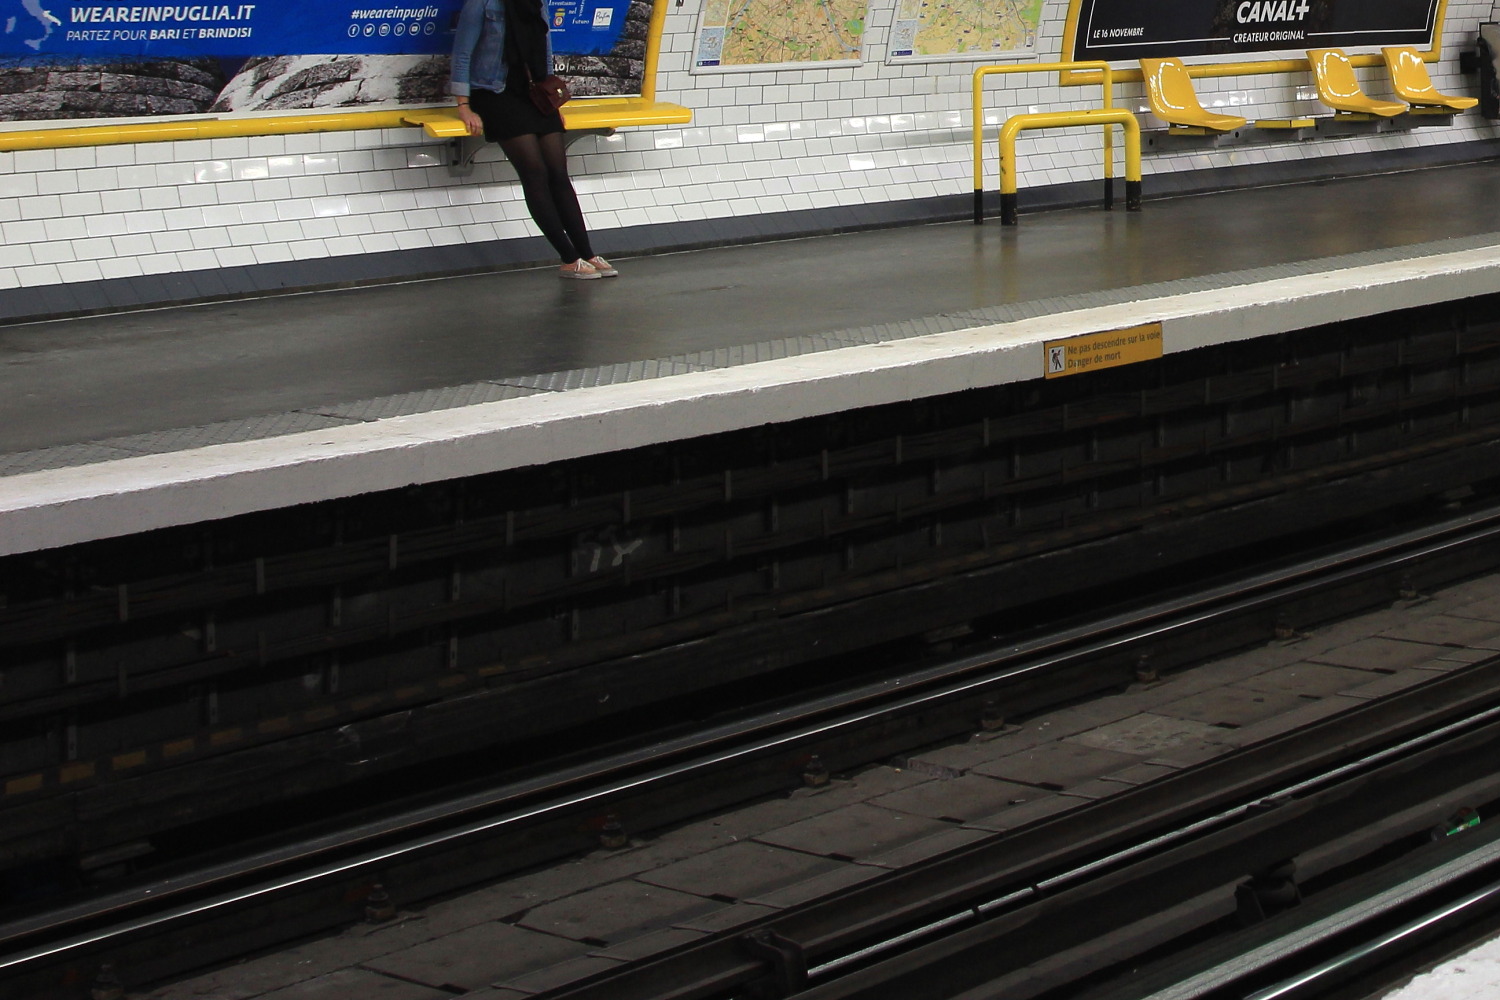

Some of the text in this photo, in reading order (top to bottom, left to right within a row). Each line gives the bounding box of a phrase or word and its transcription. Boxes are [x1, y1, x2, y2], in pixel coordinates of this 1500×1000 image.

[71, 4, 256, 23] WEAREINPUGLIA.IT
[351, 5, 439, 21] #weareinpuglia
[67, 27, 252, 41] PARTEZ POUR BARI ET BRINDISI
[1093, 27, 1145, 39] LE 16 NOVEMBRE
[1269, 30, 1305, 41] ORIGINAL
[1068, 331, 1161, 356] Ne pas descendre sur la voie
[1068, 351, 1121, 369] Danger de mort
